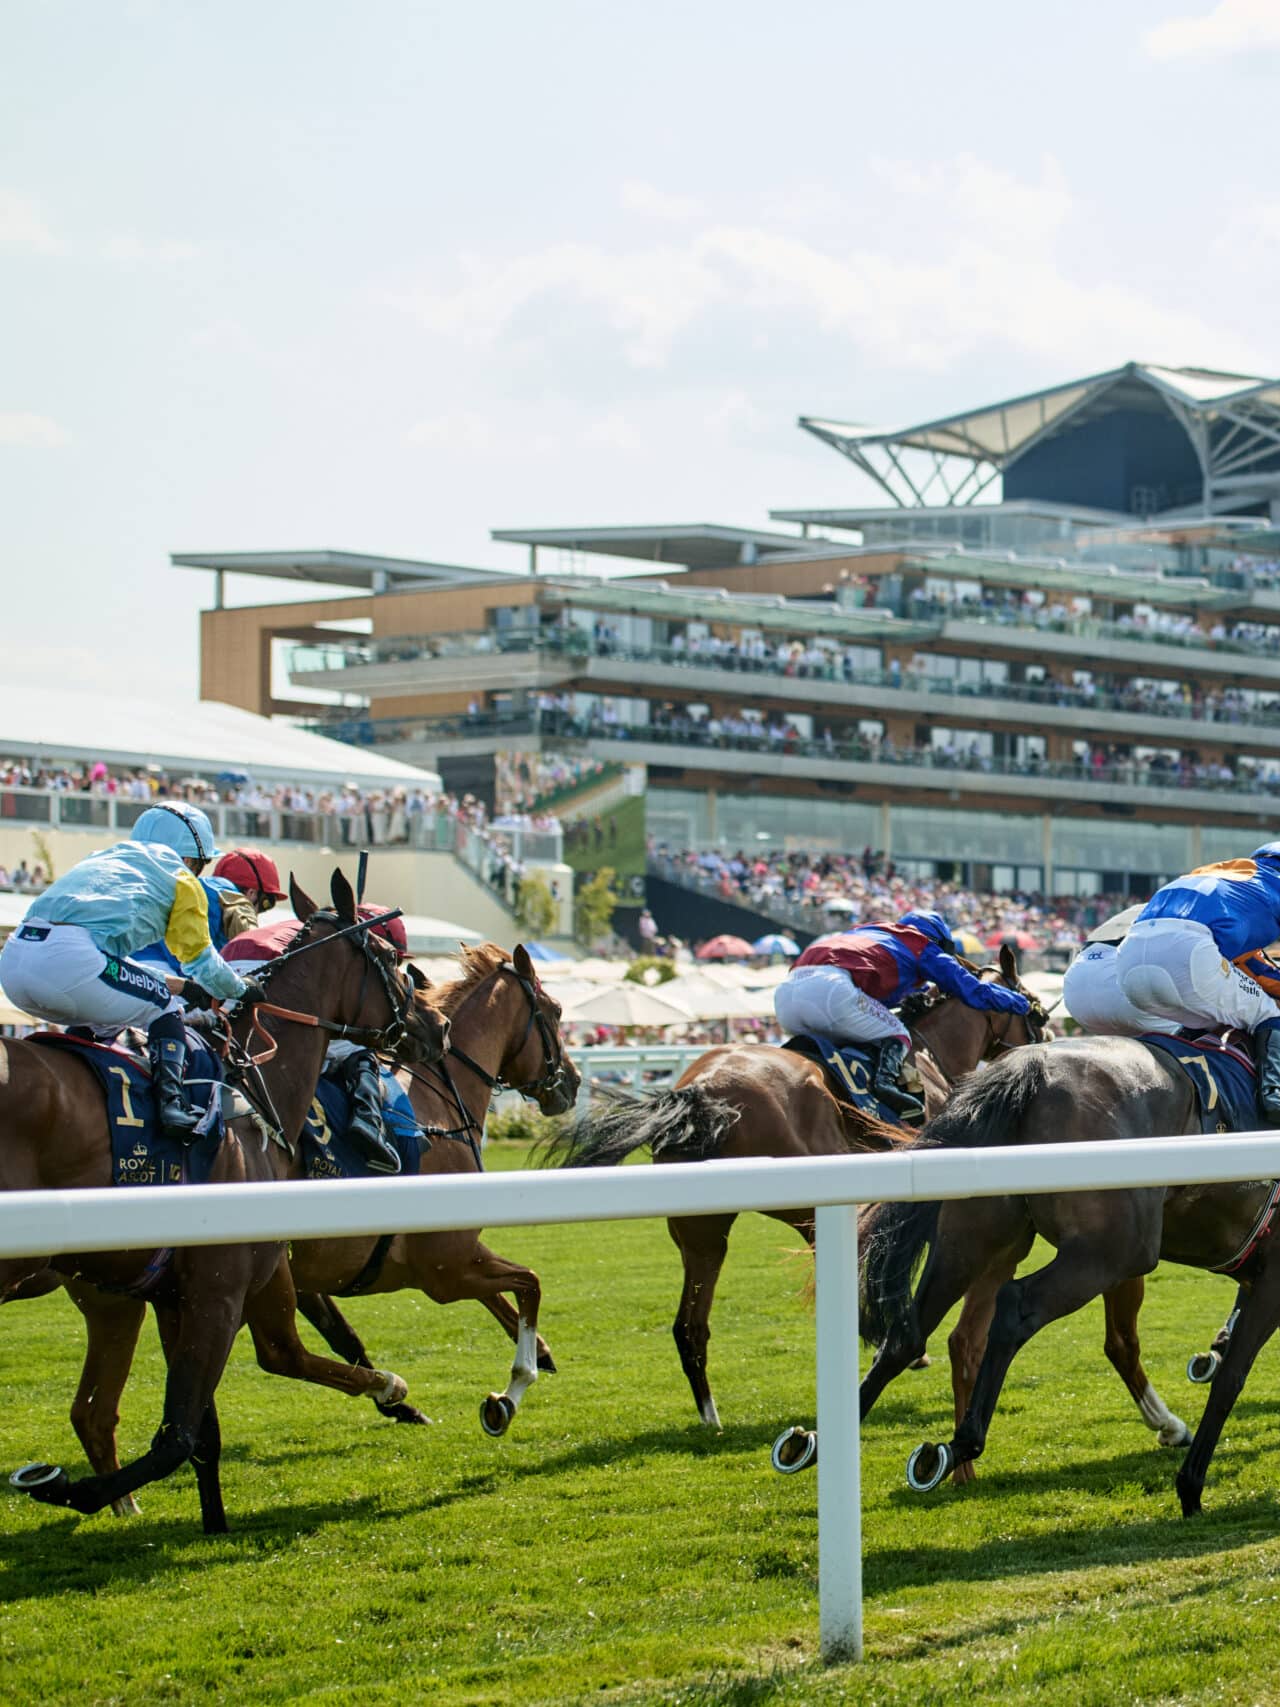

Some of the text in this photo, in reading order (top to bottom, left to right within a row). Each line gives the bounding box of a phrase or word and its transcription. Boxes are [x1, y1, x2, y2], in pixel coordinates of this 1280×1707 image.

[120, 966, 169, 999] Duelbits
[108, 1066, 144, 1128] 1
[1178, 1055, 1218, 1110] 7
[306, 1096, 332, 1145] 9
[119, 1158, 157, 1170] ROY
